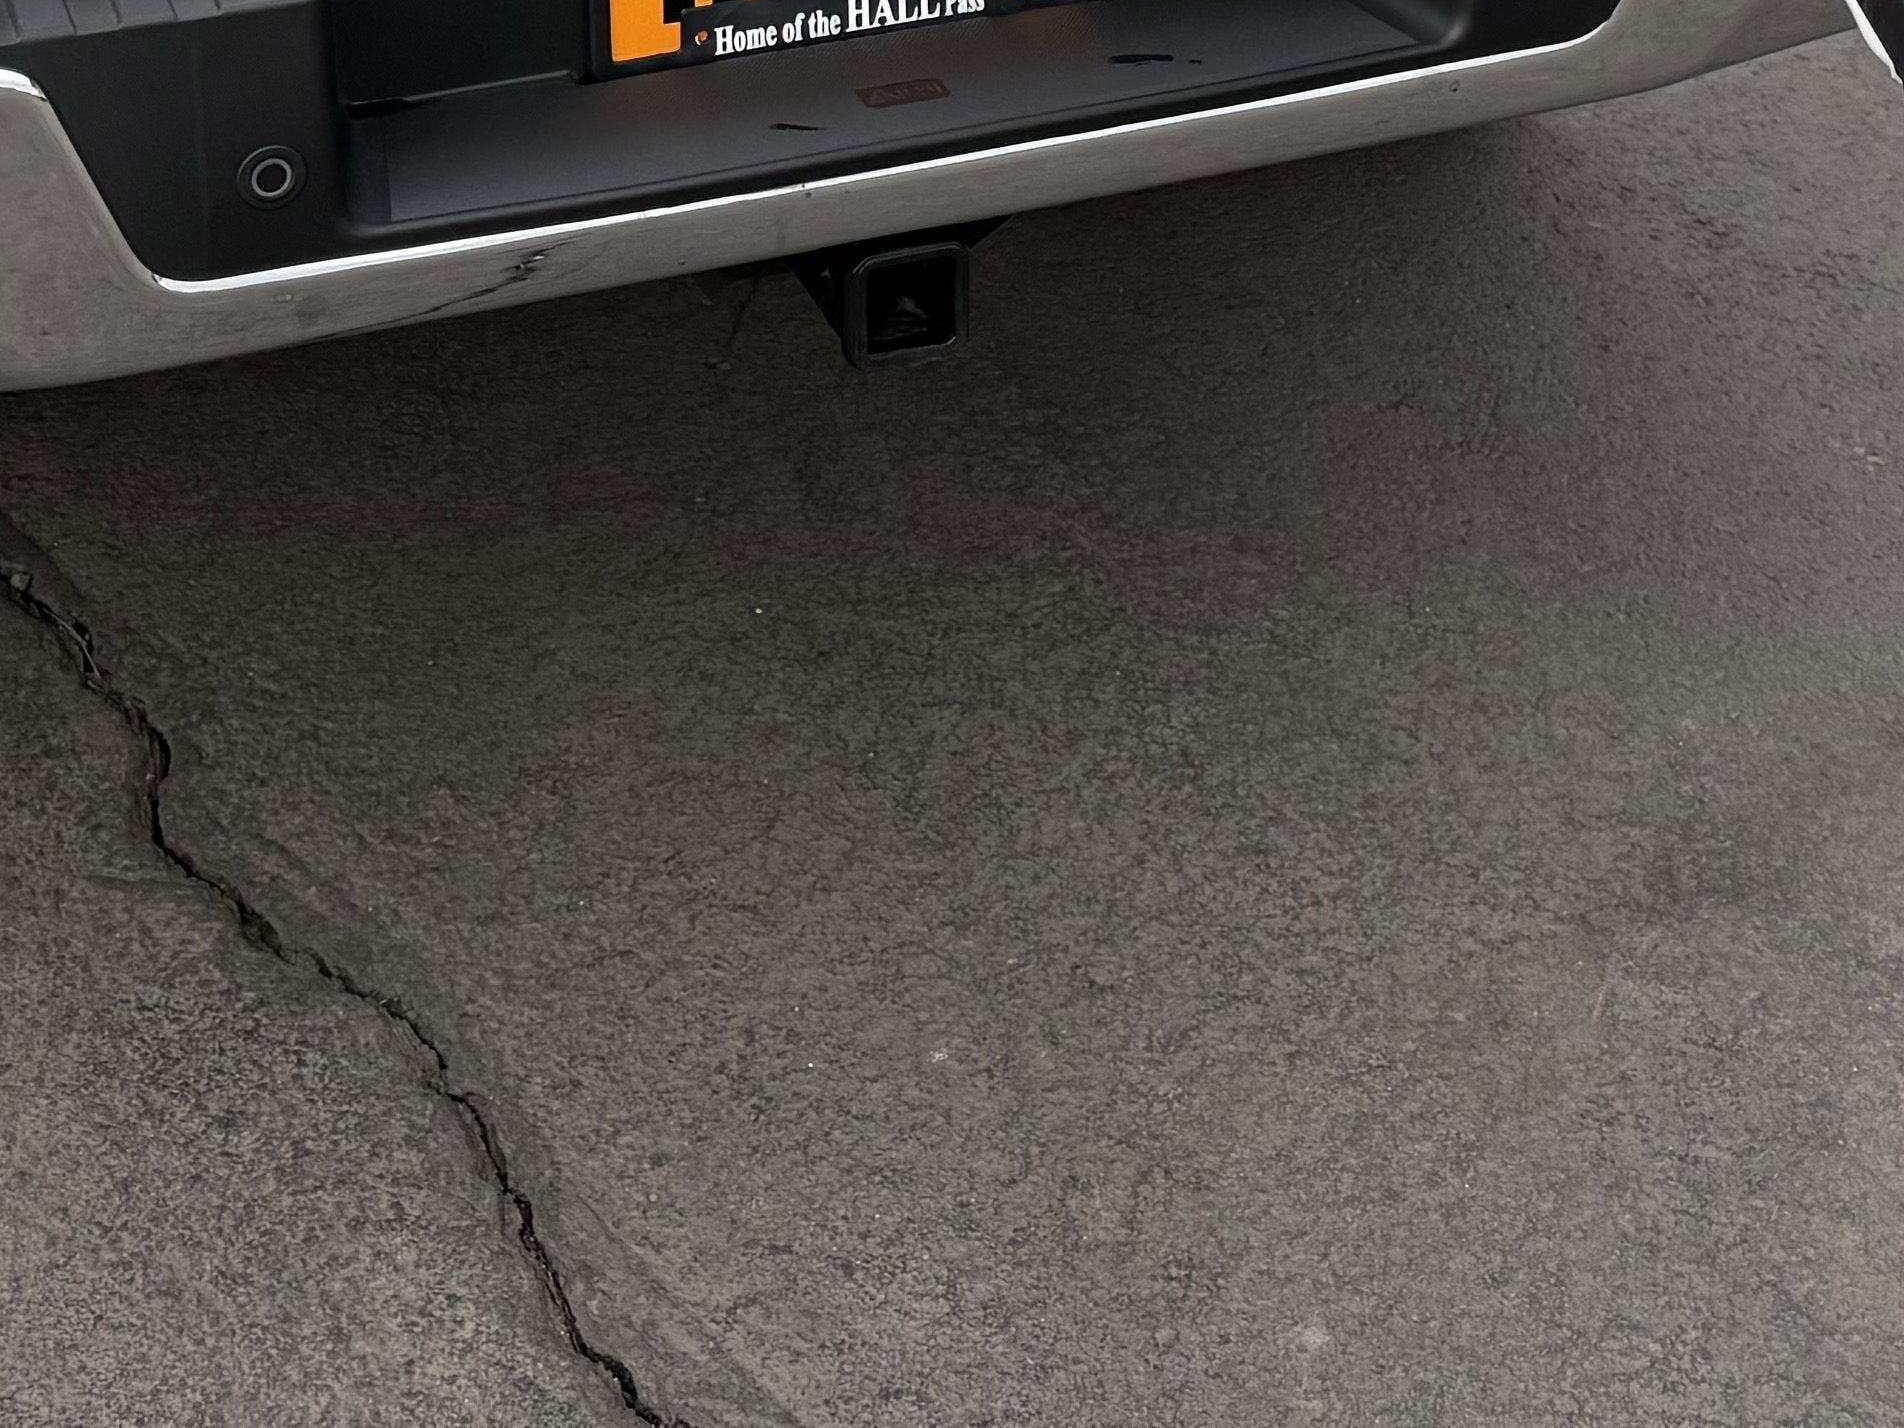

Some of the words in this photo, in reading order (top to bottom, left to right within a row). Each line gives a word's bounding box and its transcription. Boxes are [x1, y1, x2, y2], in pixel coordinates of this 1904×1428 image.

[714, 24, 777, 56] Home
[783, 12, 806, 43] of
[808, 10, 841, 39] the
